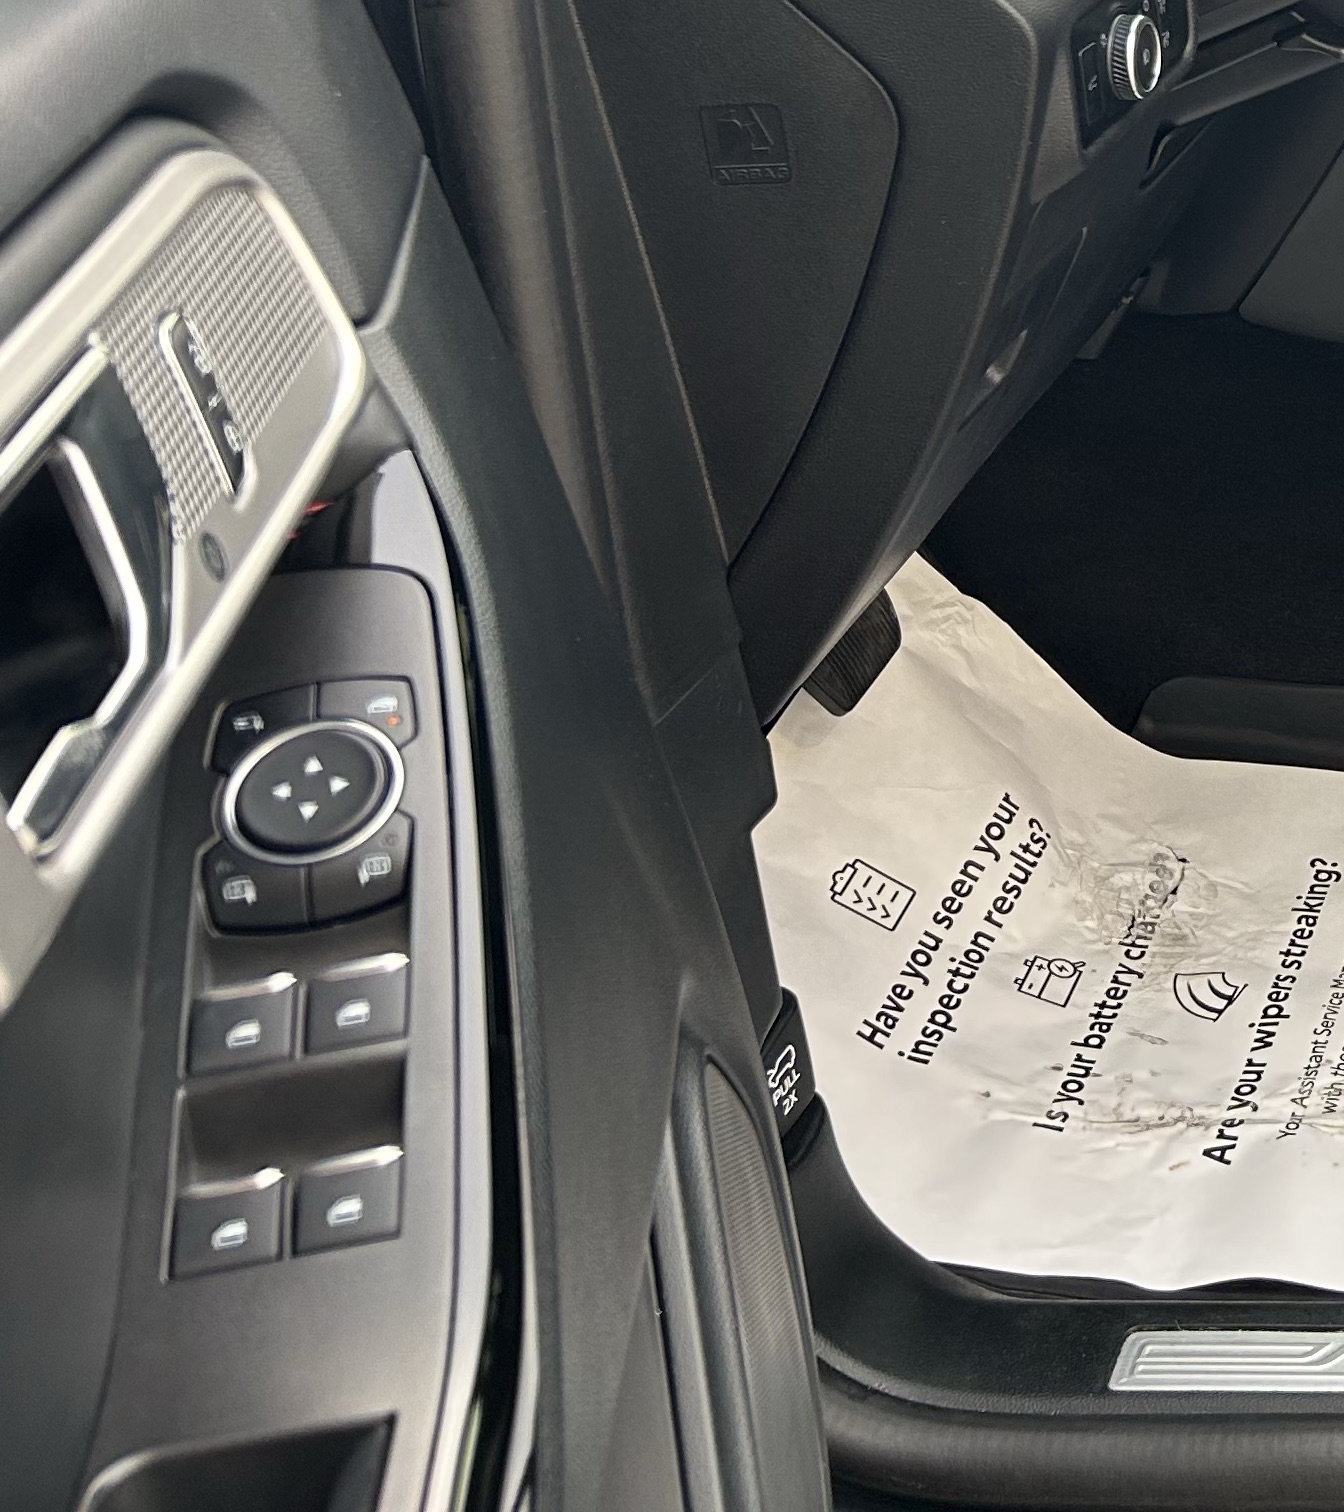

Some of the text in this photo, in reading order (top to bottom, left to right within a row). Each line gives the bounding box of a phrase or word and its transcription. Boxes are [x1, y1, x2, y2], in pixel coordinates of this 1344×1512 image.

[856, 793, 1020, 1049] Have you seen your
[897, 817, 1052, 1065] inspection results?
[1071, 962, 1144, 1049] battery
[1201, 857, 1341, 1166] Are your wipers streaking?
[772, 1069, 800, 1107] PULL
[1053, 1053, 1096, 1105] your
[1276, 1115, 1304, 1141] Your
[1290, 1036, 1327, 1108] Assistant
[1314, 993, 1343, 1038] Service
[1322, 1077, 1340, 1115] with
[782, 1089, 798, 1116] 2X
[1032, 1109, 1069, 1132] Is
